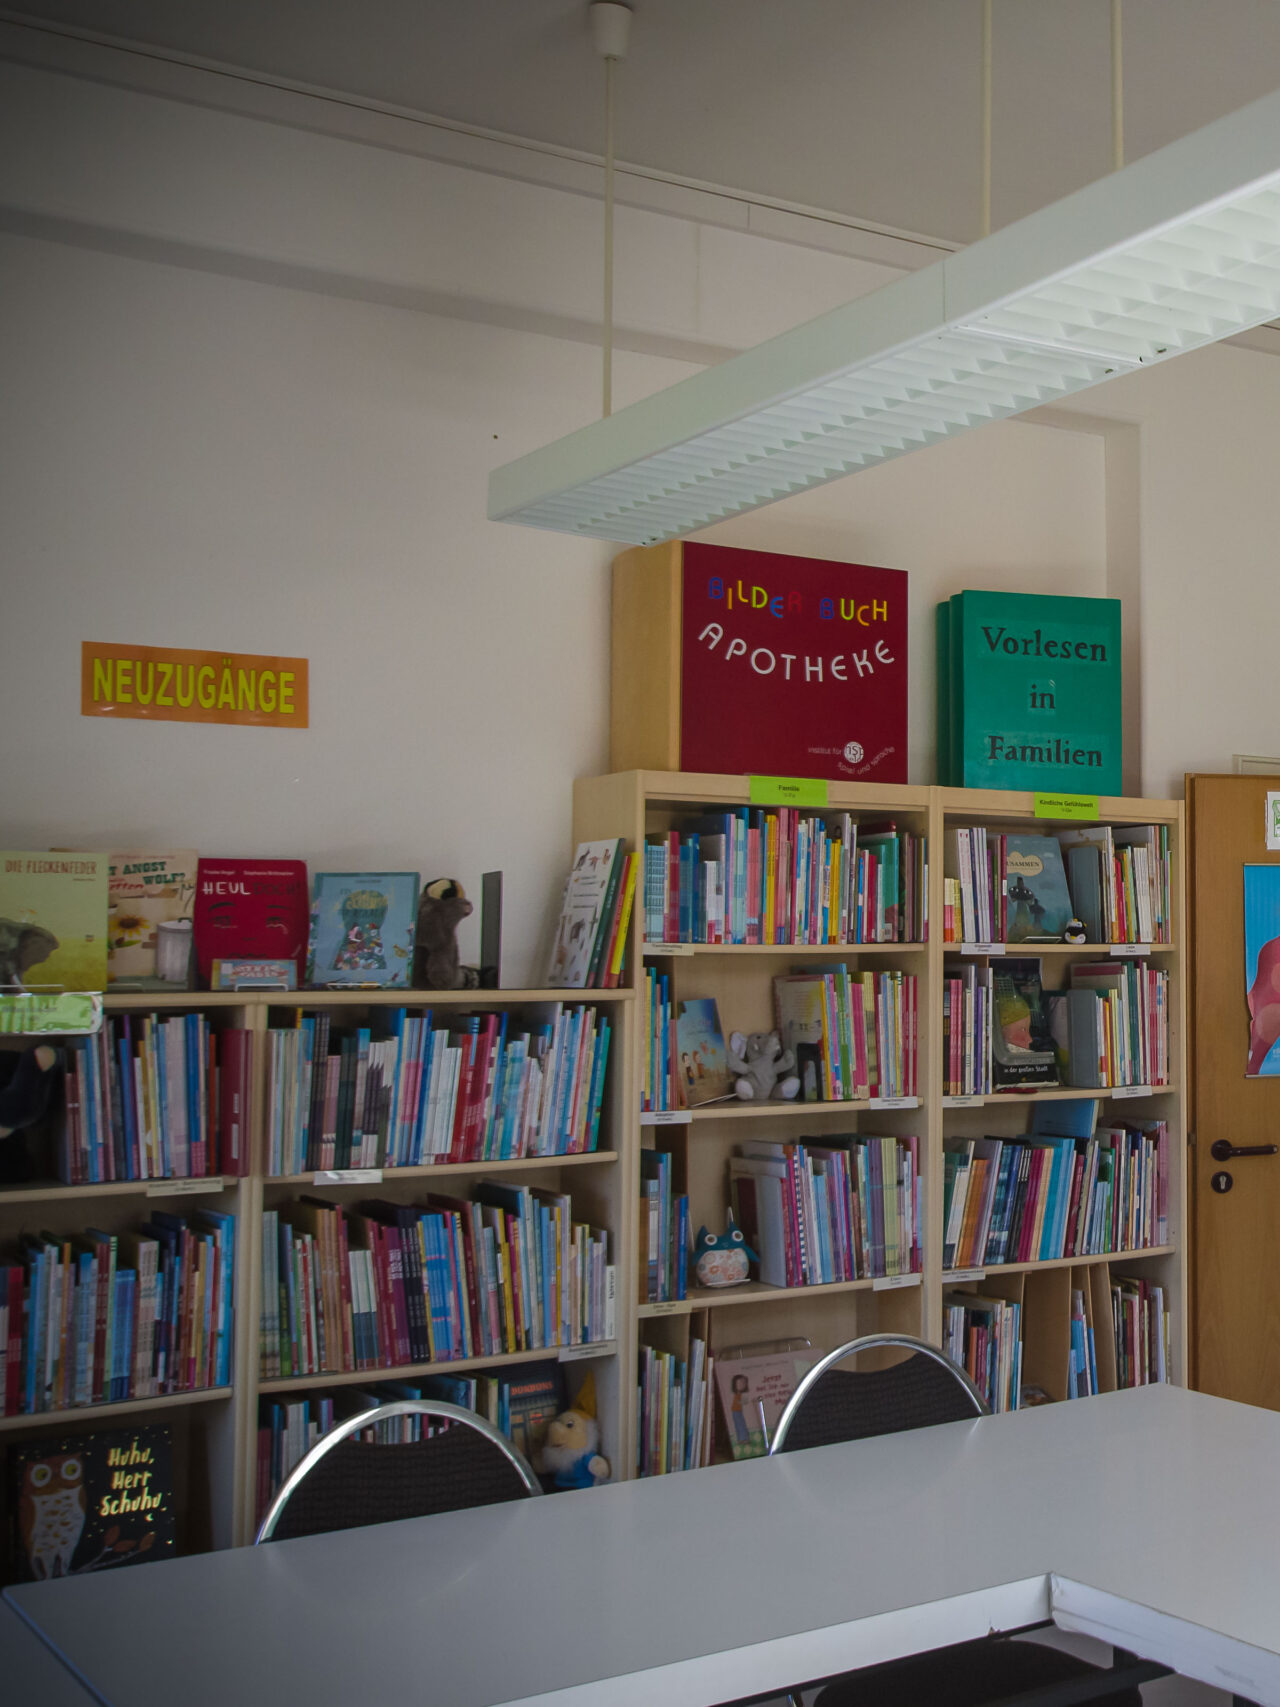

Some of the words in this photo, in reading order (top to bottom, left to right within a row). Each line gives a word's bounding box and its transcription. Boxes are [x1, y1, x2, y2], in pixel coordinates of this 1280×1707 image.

[708, 577, 800, 618] BILDER
[819, 597, 889, 626] BUCH
[698, 622, 896, 683] APOTHEKE
[981, 625, 1108, 663] Vorlesen
[93, 658, 296, 714] NEUZUGÄNGE
[1028, 684, 1056, 710] in
[987, 734, 1103, 768] Familien
[777, 784, 800, 792] Familie
[5, 860, 22, 874] DIE
[26, 860, 97, 874] FLECKENFEDER
[123, 861, 168, 875] ANGST
[142, 873, 186, 886] WOLF?
[202, 881, 252, 896] HEUL
[107, 1441, 155, 1468] Huhu,
[110, 1470, 153, 1490] Herr
[99, 1487, 164, 1518] Schuhu
